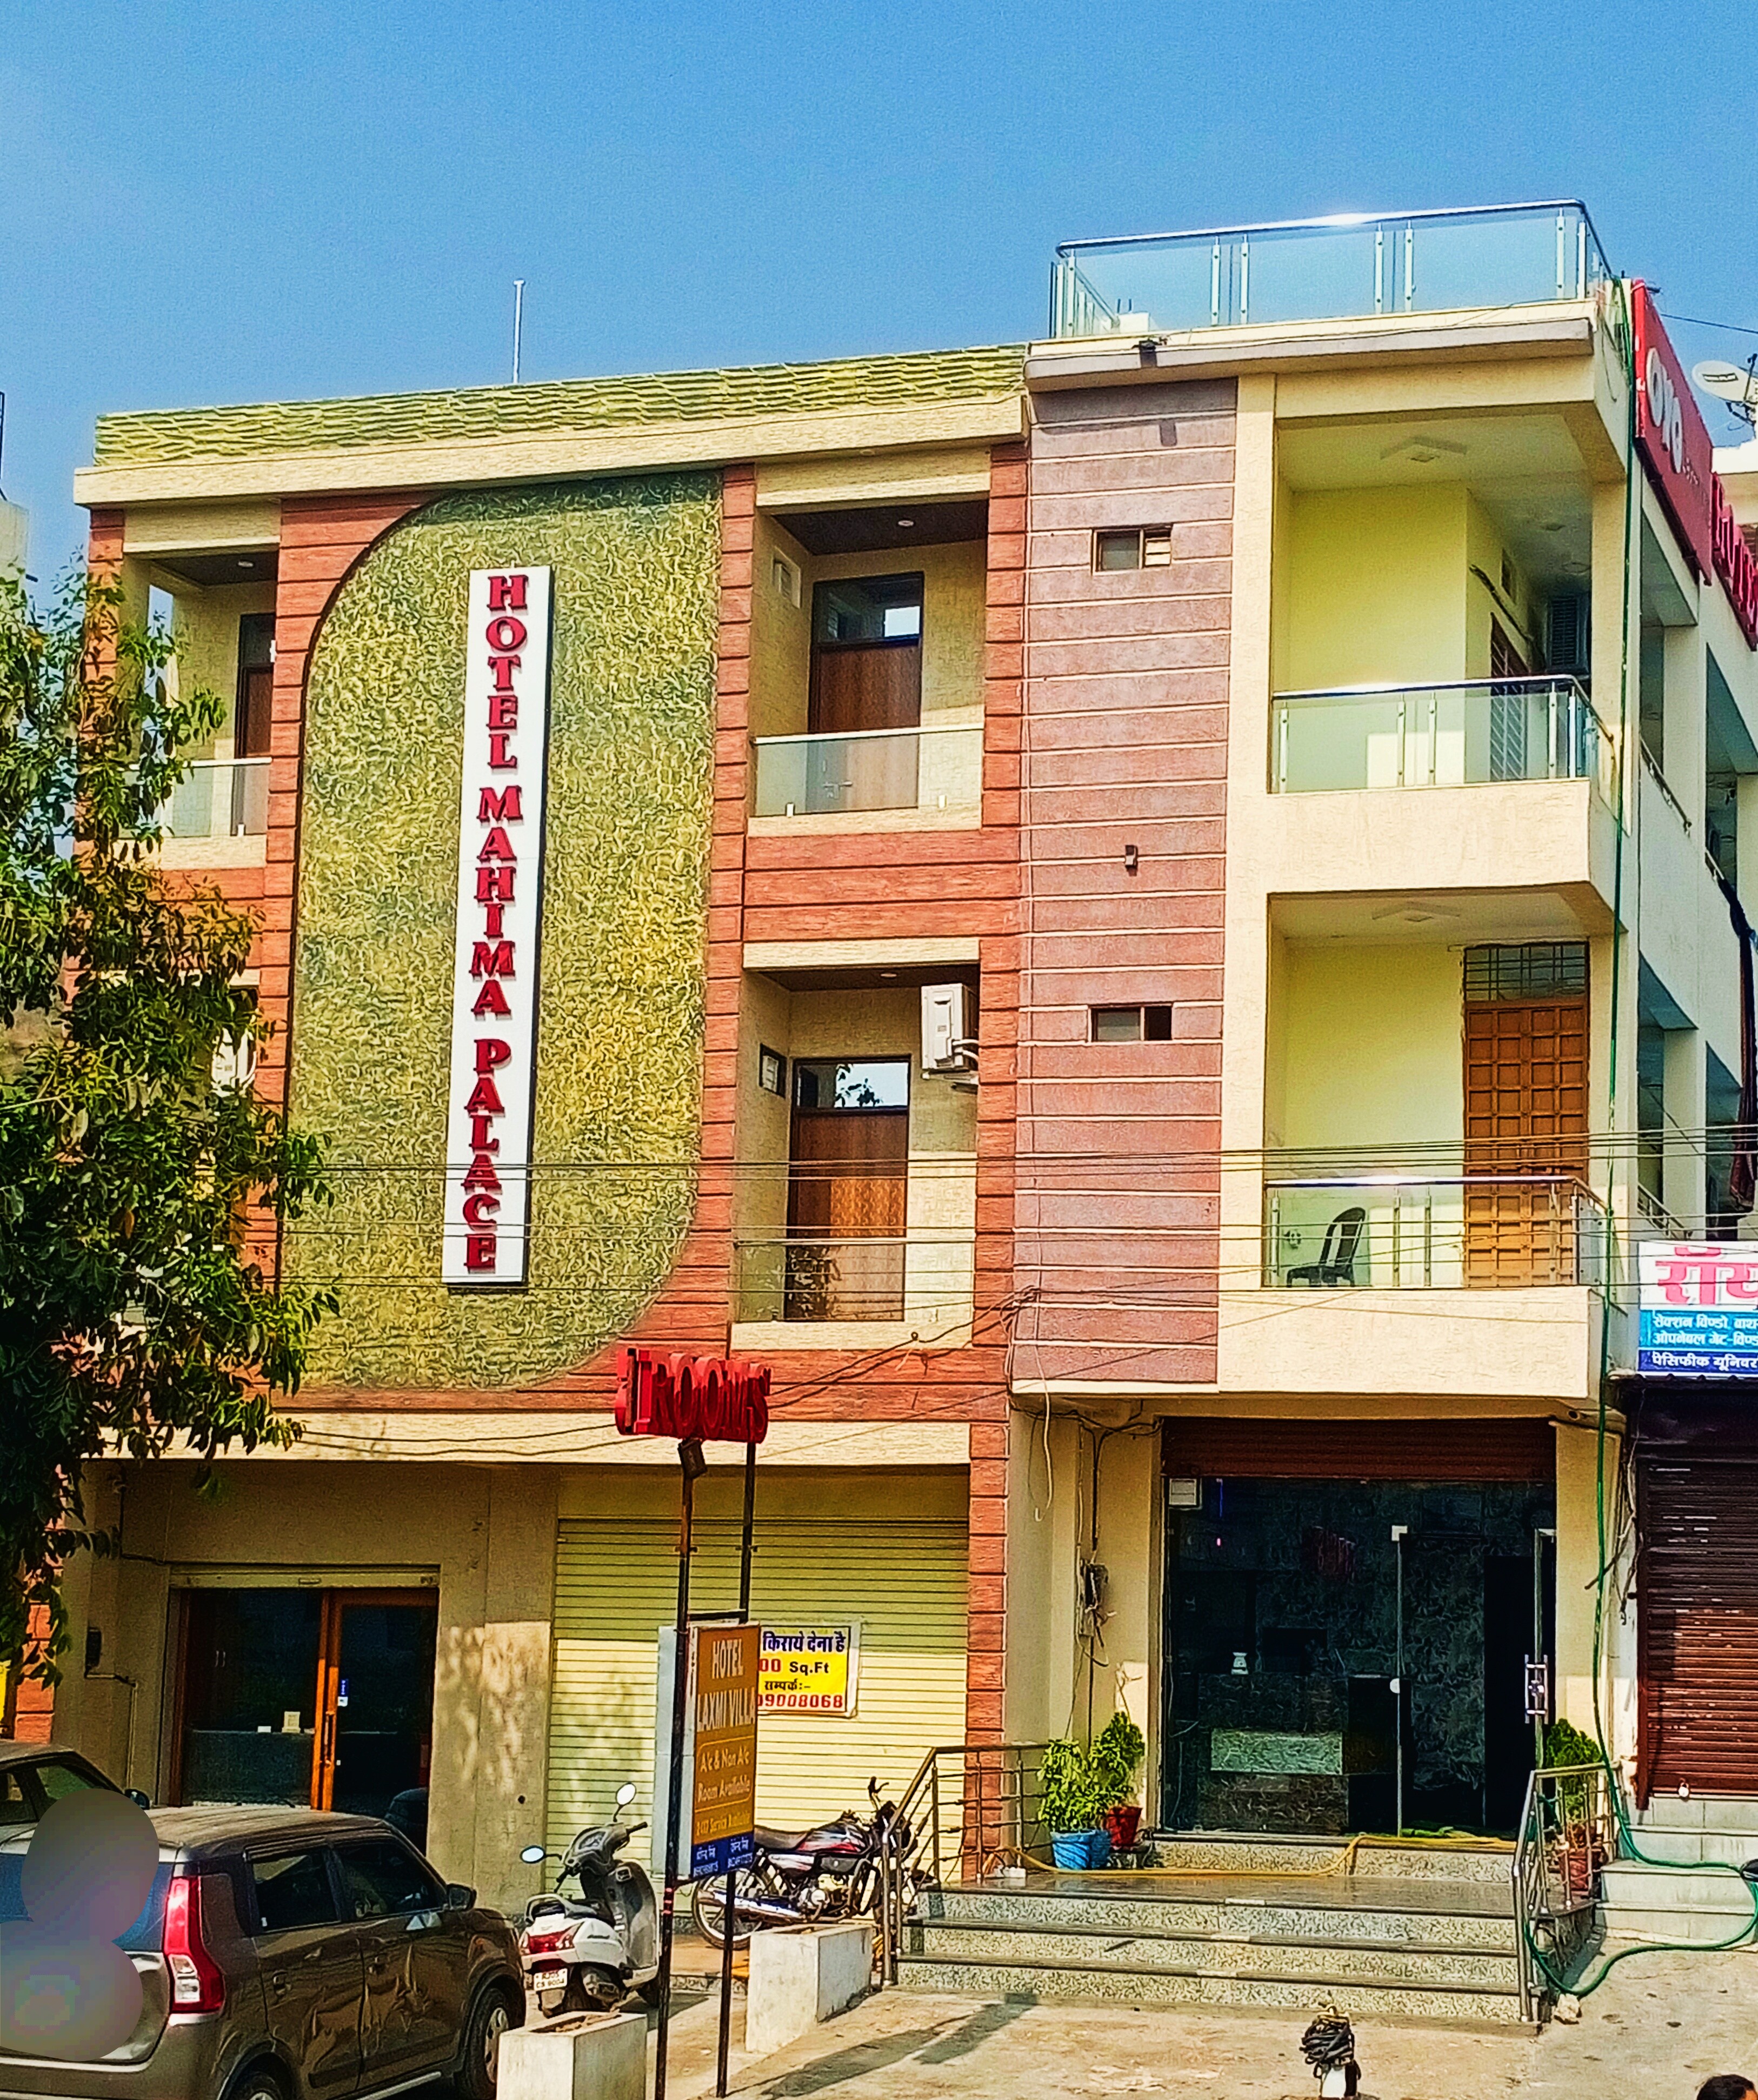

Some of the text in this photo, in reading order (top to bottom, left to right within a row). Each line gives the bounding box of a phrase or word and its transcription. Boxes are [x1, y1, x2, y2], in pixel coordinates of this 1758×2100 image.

[461, 575, 529, 1271] HOTEL MAHIMA PALACE
[711, 1638, 744, 1679] HOTEL
[763, 1631, 846, 1652] किराये देना है
[789, 1662, 829, 1676] Sq.Ft
[697, 1686, 756, 1732] LAXMI VILLA
